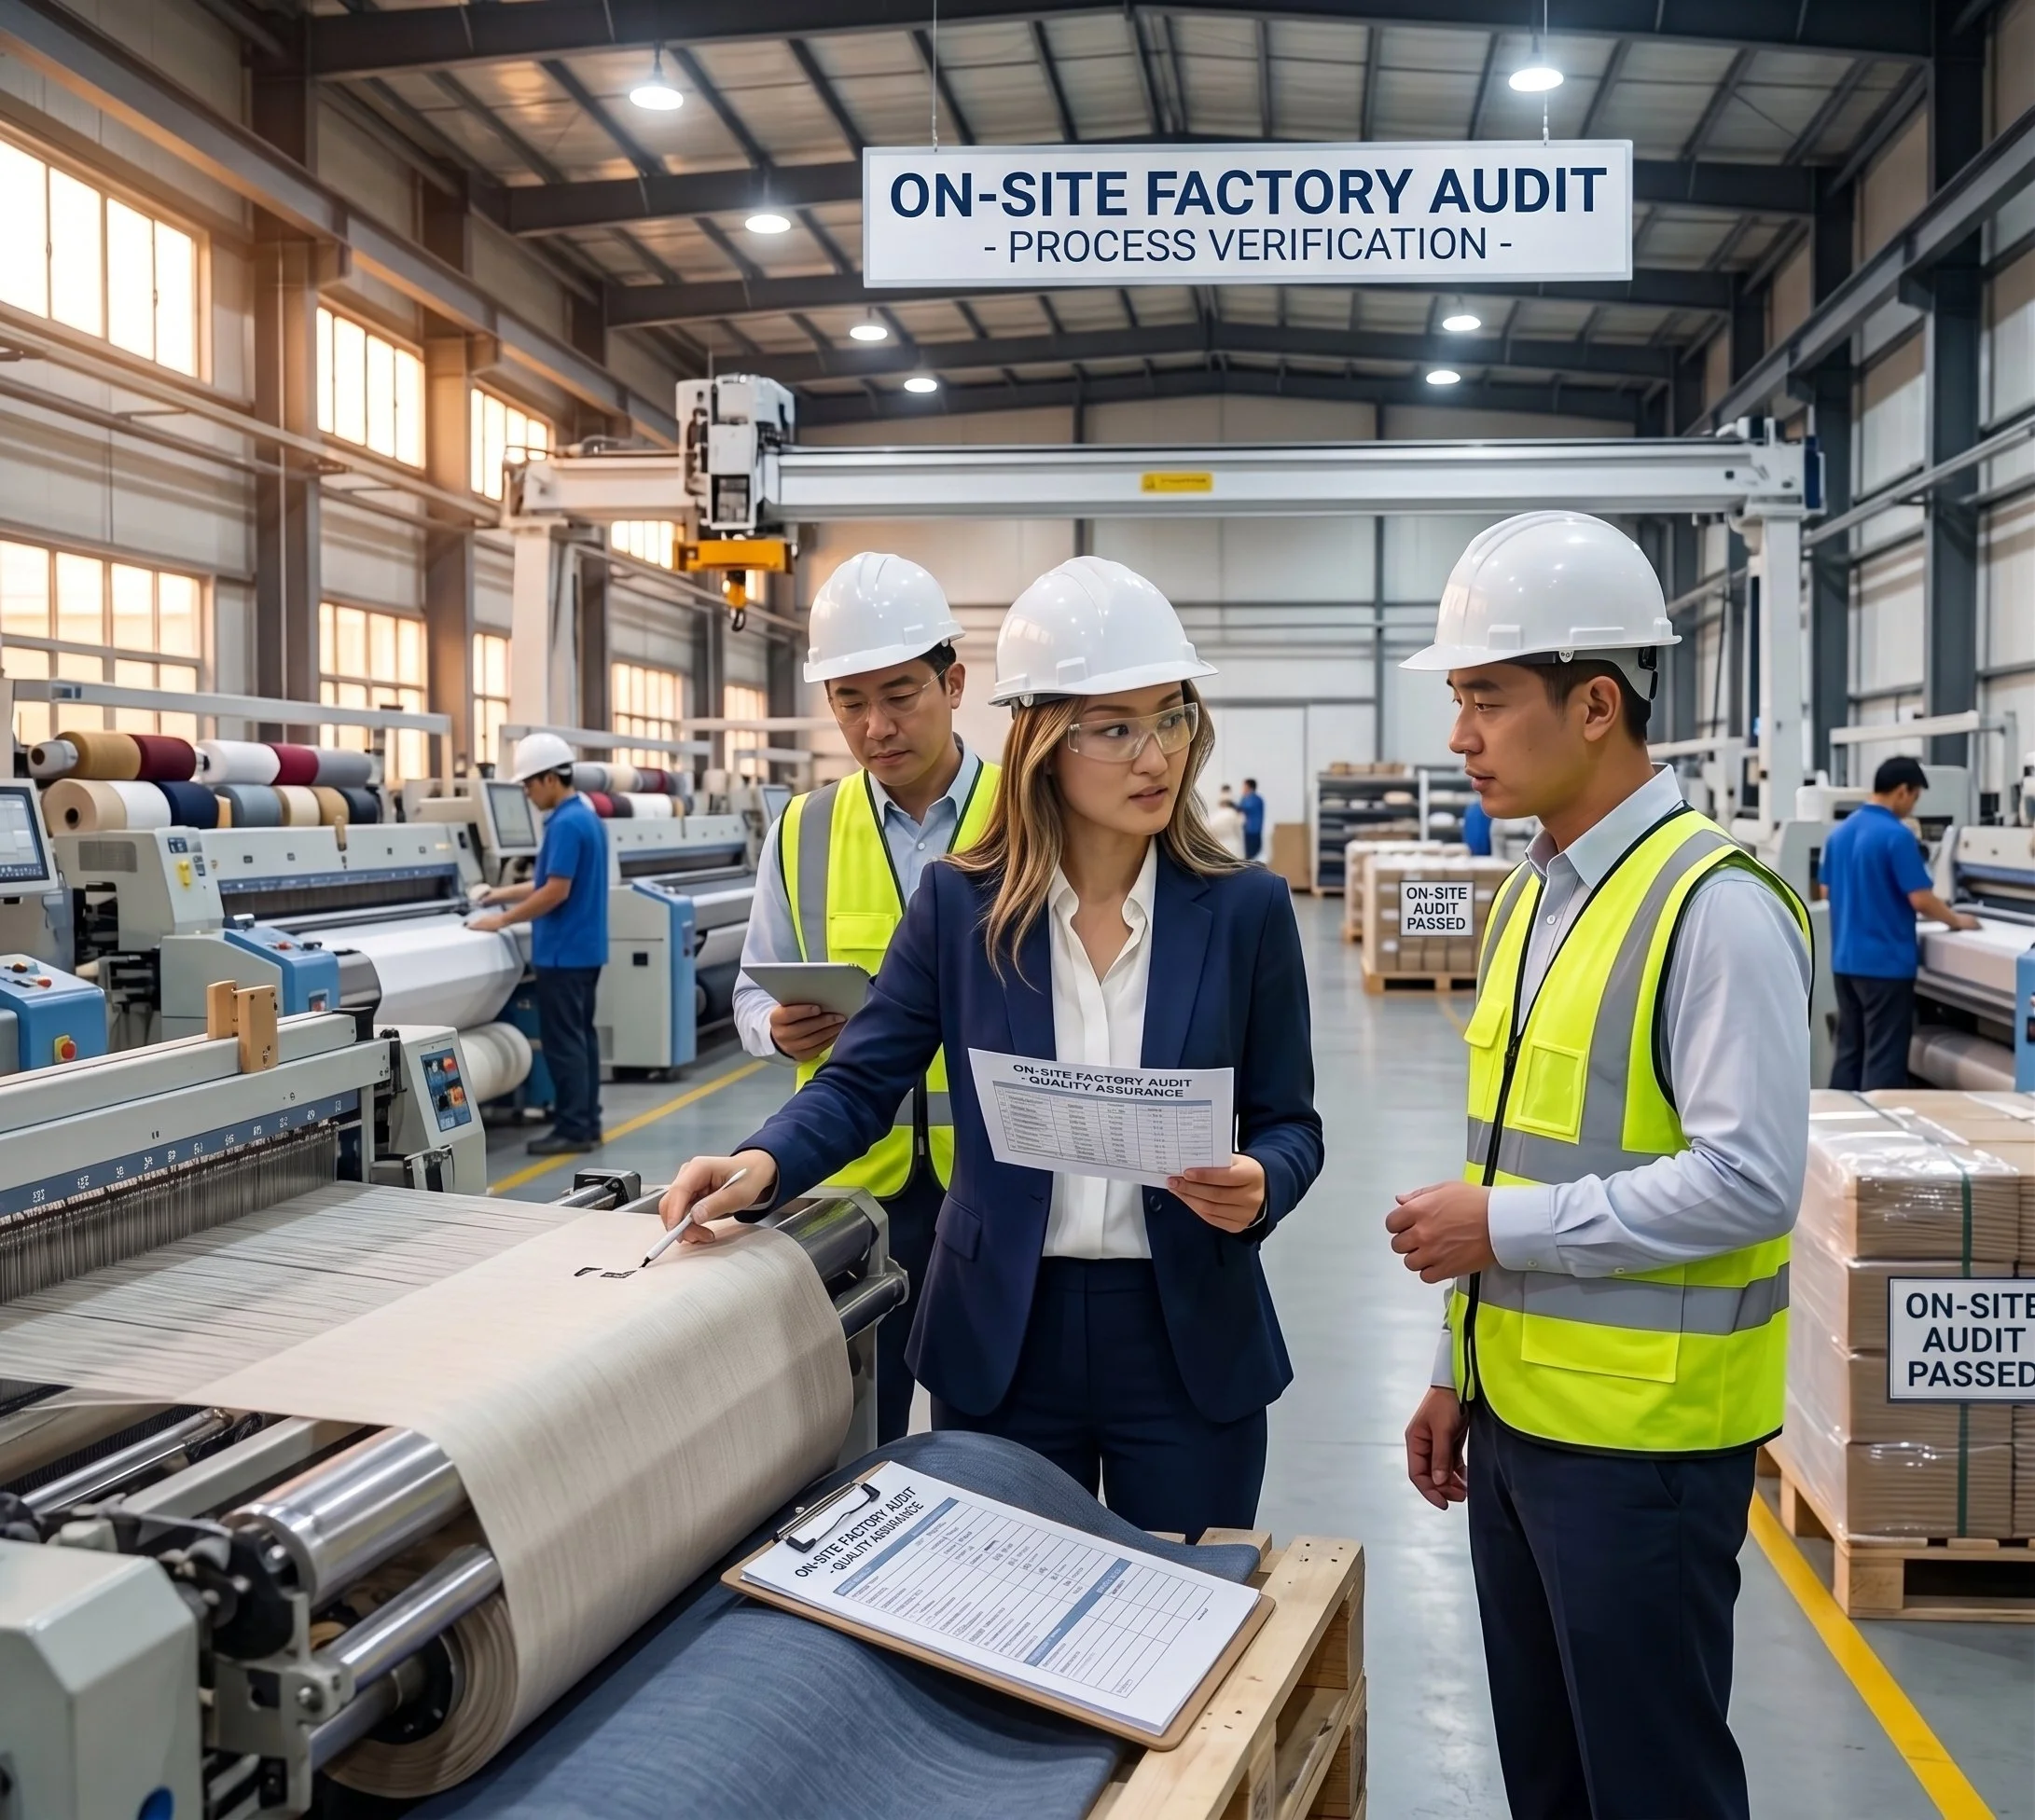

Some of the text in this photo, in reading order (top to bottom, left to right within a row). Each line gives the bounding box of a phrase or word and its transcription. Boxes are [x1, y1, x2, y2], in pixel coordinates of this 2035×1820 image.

[890, 167, 1608, 218] ON-SITE FACTORY AUDIT
[1010, 228, 1197, 264] PROCESS
[1208, 227, 1486, 262] VERIFICATION
[1406, 887, 1467, 900] ON-SITE
[1413, 903, 1459, 915] AUDIT
[1406, 917, 1466, 930] PASSED
[1013, 1064, 1192, 1087] ON-SITE FACTORY AUDIT
[1029, 1076, 1091, 1091] QUALITY
[1095, 1082, 1184, 1097] ASSURANCE
[1921, 1326, 2027, 1353] AUDIT
[1908, 1360, 2035, 1388] PASSED
[795, 1542, 844, 1578] ON-SITE
[838, 1509, 888, 1546] FACTORY
[885, 1485, 917, 1512] AUDIT
[832, 1539, 873, 1571] QUALITY
